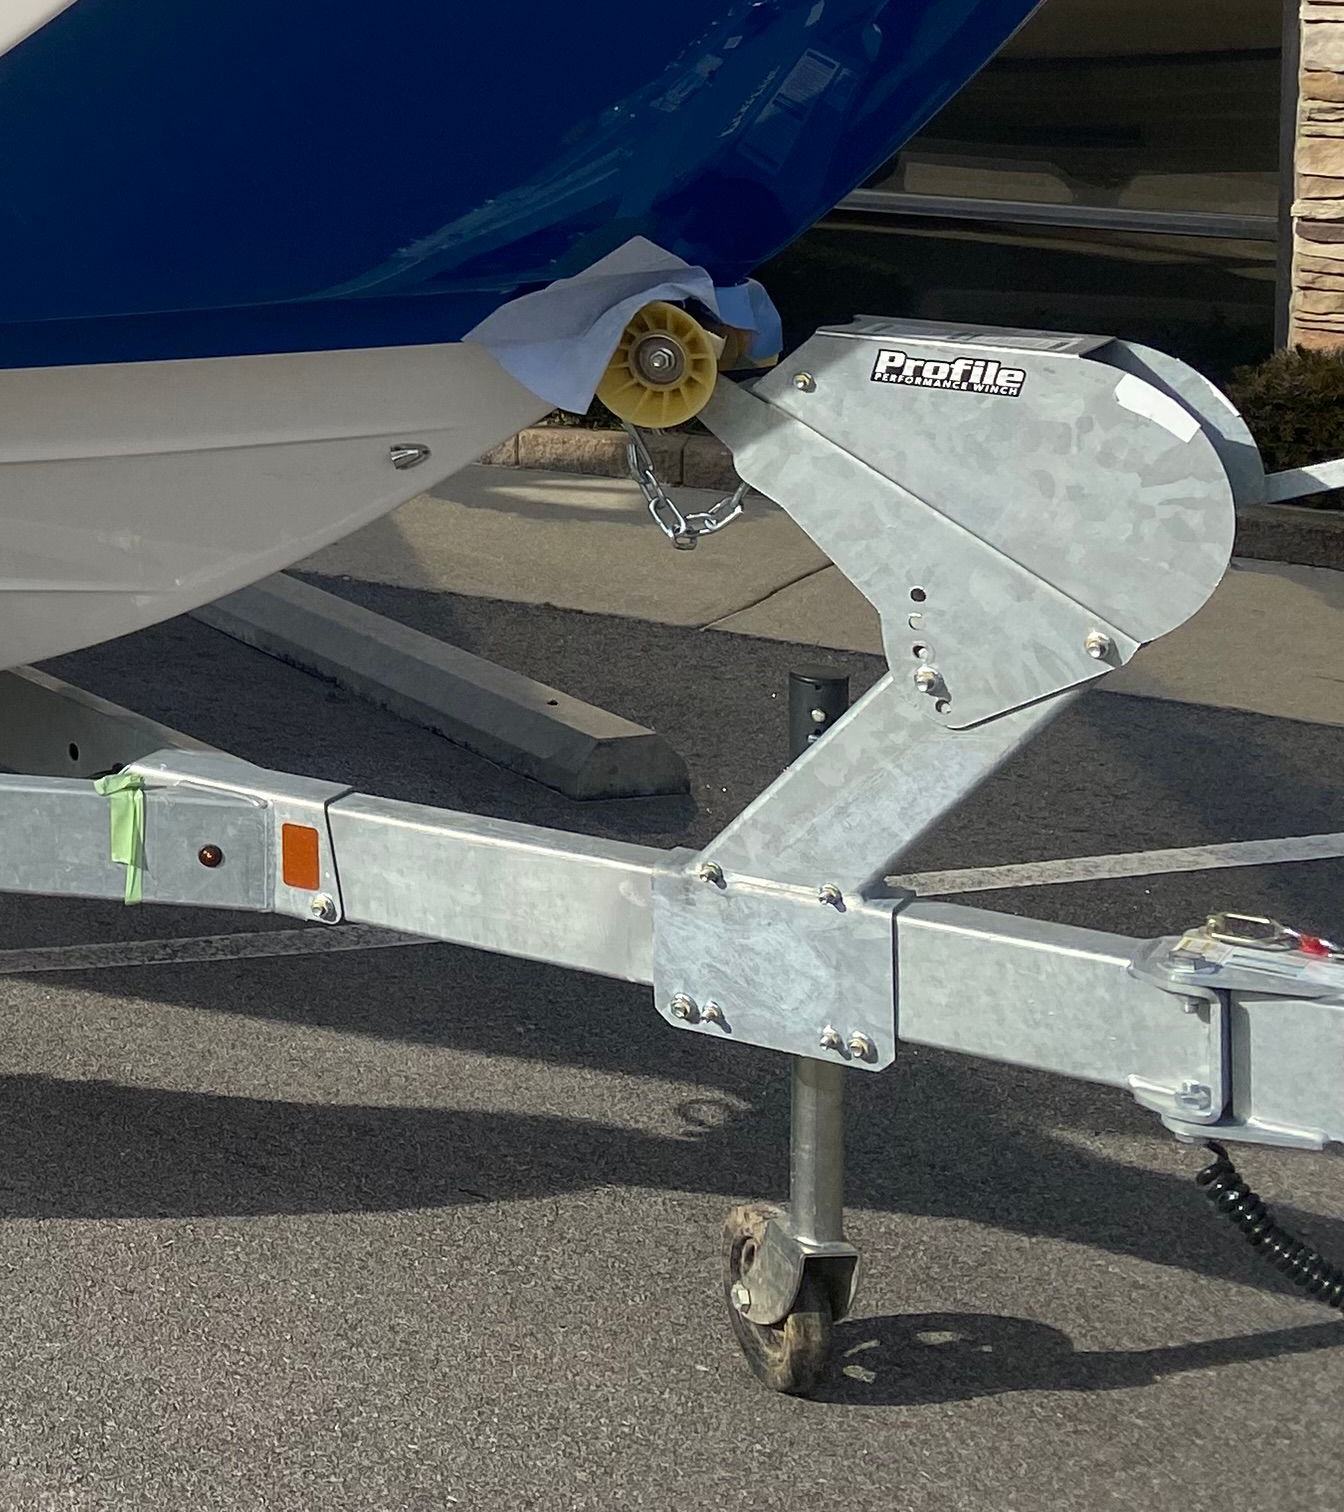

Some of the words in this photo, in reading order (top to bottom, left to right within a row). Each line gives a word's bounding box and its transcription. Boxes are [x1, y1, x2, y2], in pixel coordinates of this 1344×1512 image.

[873, 371, 969, 392] PERFORMANCE
[972, 382, 1019, 397] WINCH
[874, 349, 1025, 389] Profile
